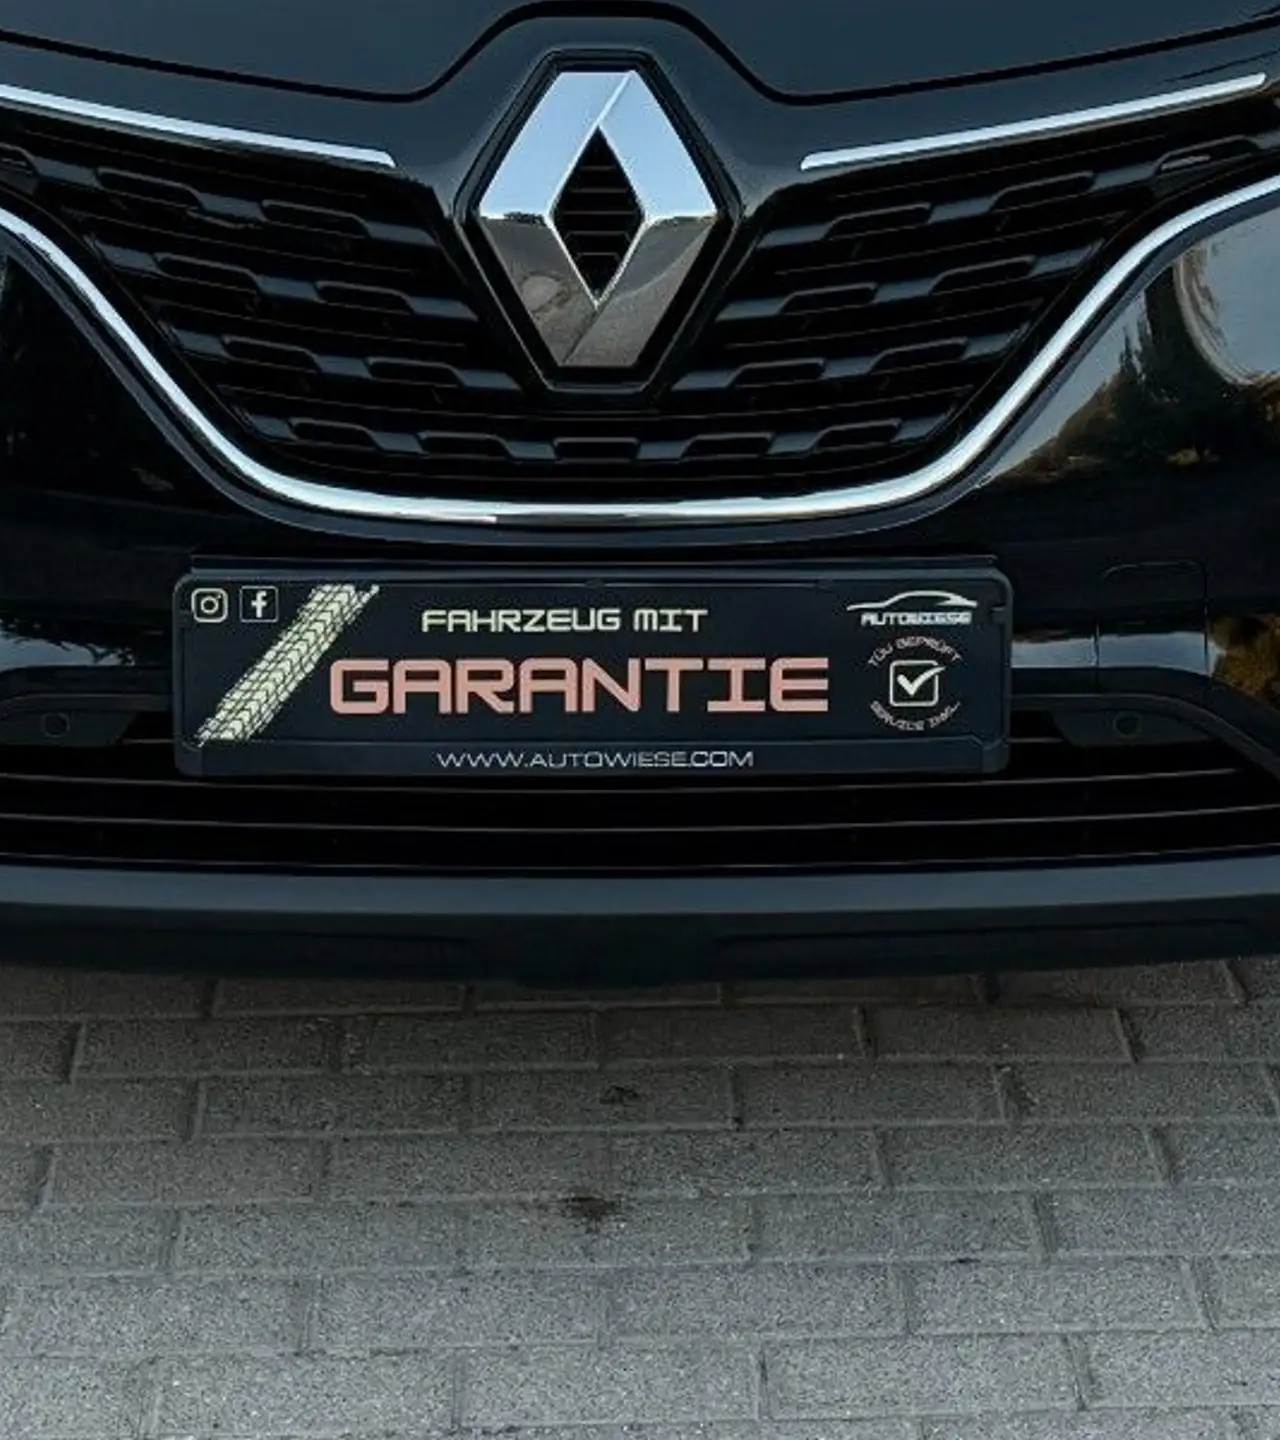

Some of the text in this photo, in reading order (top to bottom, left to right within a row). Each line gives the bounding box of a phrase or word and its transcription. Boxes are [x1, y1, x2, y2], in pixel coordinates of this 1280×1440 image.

[421, 608, 709, 633] FAHRZEUG MIT
[861, 611, 971, 626] AUTOWIESE
[330, 657, 829, 714] GARANTIE
[437, 751, 754, 768] WWW.AUTOWIESE.COM
